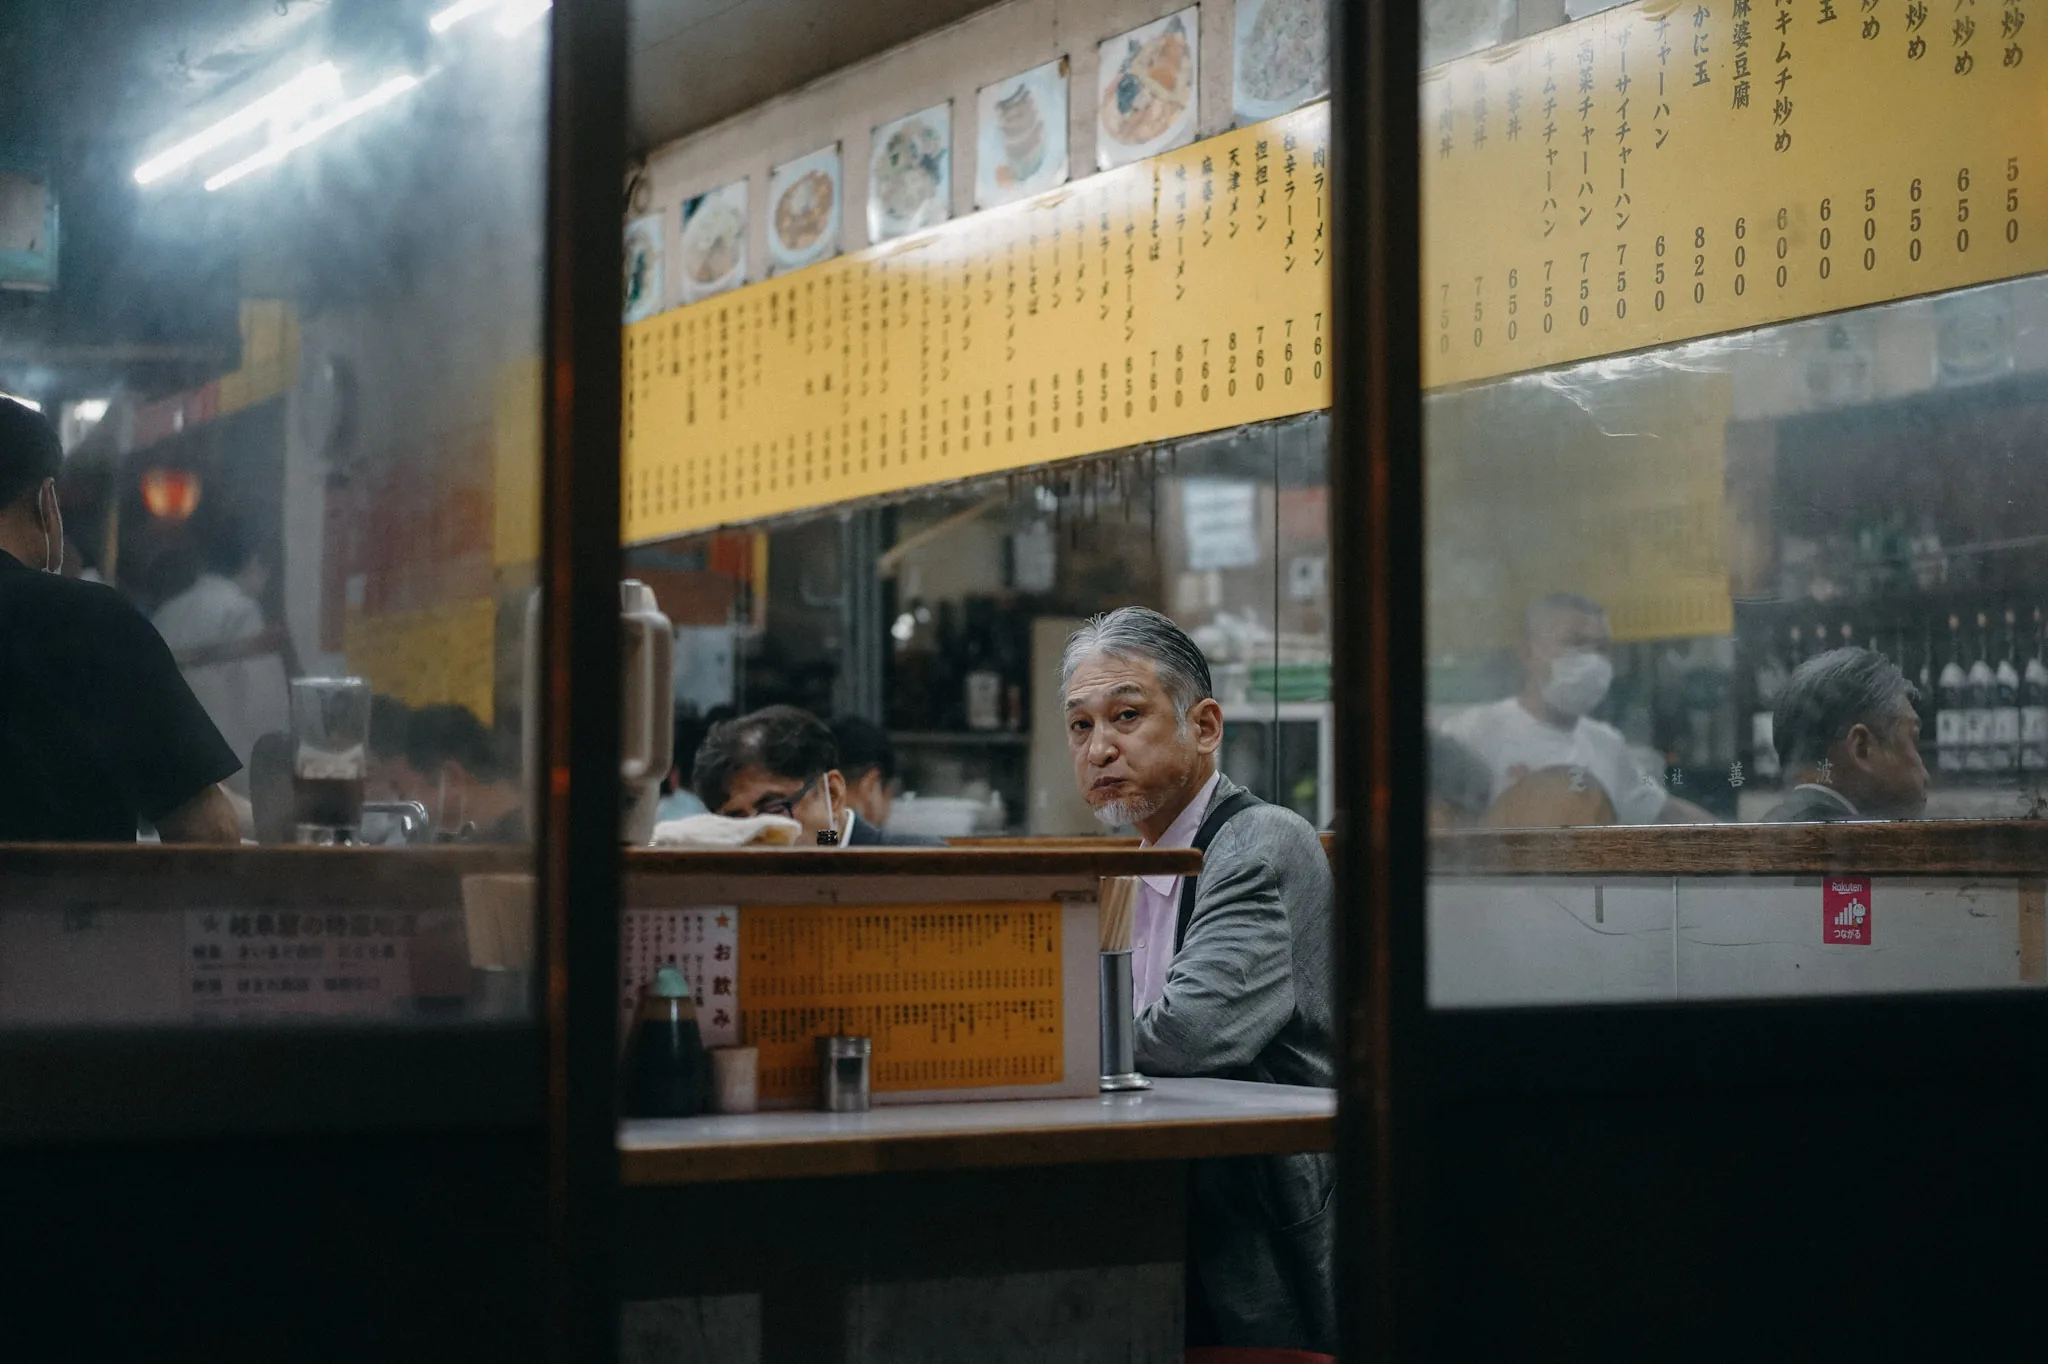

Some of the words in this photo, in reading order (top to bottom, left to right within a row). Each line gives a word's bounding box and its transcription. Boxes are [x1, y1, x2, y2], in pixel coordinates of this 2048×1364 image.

[1692, 4, 1710, 87] かに玉
[2001, 0, 2025, 68] 炒め
[1653, 15, 1671, 149] チャーハン
[1577, 38, 1596, 227] 高菜チャーハン
[1227, 147, 1240, 239] 天津メン
[1864, 189, 1876, 271] 500
[1909, 178, 1922, 262] 650
[1957, 168, 1970, 252] 650
[2006, 157, 2019, 243] 550
[1655, 235, 1665, 312] 650
[1694, 226, 1705, 304] 820
[1735, 217, 1746, 296] 600
[1777, 207, 1788, 288] 600
[1820, 198, 1831, 279] 600
[1474, 276, 1483, 347] 750
[1508, 268, 1518, 341] 650
[1543, 260, 1553, 334] 750
[1579, 252, 1589, 327] 750
[1616, 243, 1627, 319] 750
[1285, 320, 1293, 385] 760
[1313, 313, 1322, 380] 760
[1440, 284, 1449, 355] 750
[1125, 356, 1133, 418] 650
[1201, 339, 1209, 402] 760
[1228, 332, 1236, 397] 820
[1256, 326, 1265, 391] 760
[1727, 761, 1746, 788] 善
[1816, 758, 1834, 785] 波
[1832, 882, 1862, 893] Rakuten
[1834, 929, 1861, 939] つながる
